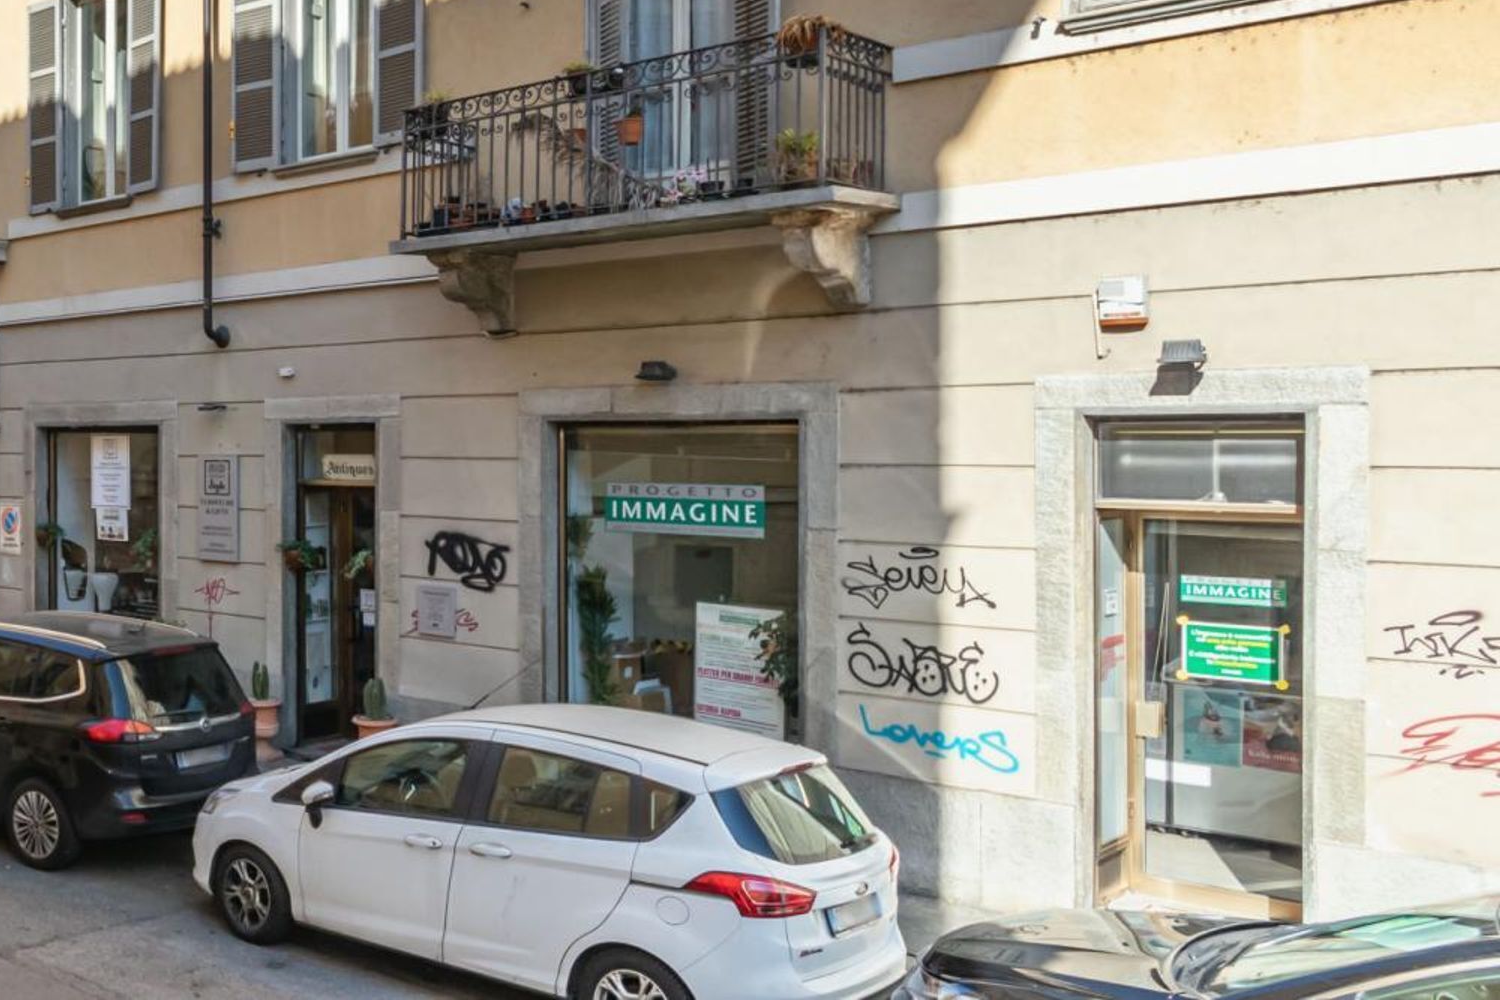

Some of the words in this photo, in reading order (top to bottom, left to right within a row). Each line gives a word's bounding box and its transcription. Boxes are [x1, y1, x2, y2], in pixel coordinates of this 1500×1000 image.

[611, 484, 757, 498] PROGETTO
[612, 500, 758, 524] IMMAGINE
[1186, 584, 1282, 599] IMMAGINE
[859, 703, 1019, 773] Lovers
